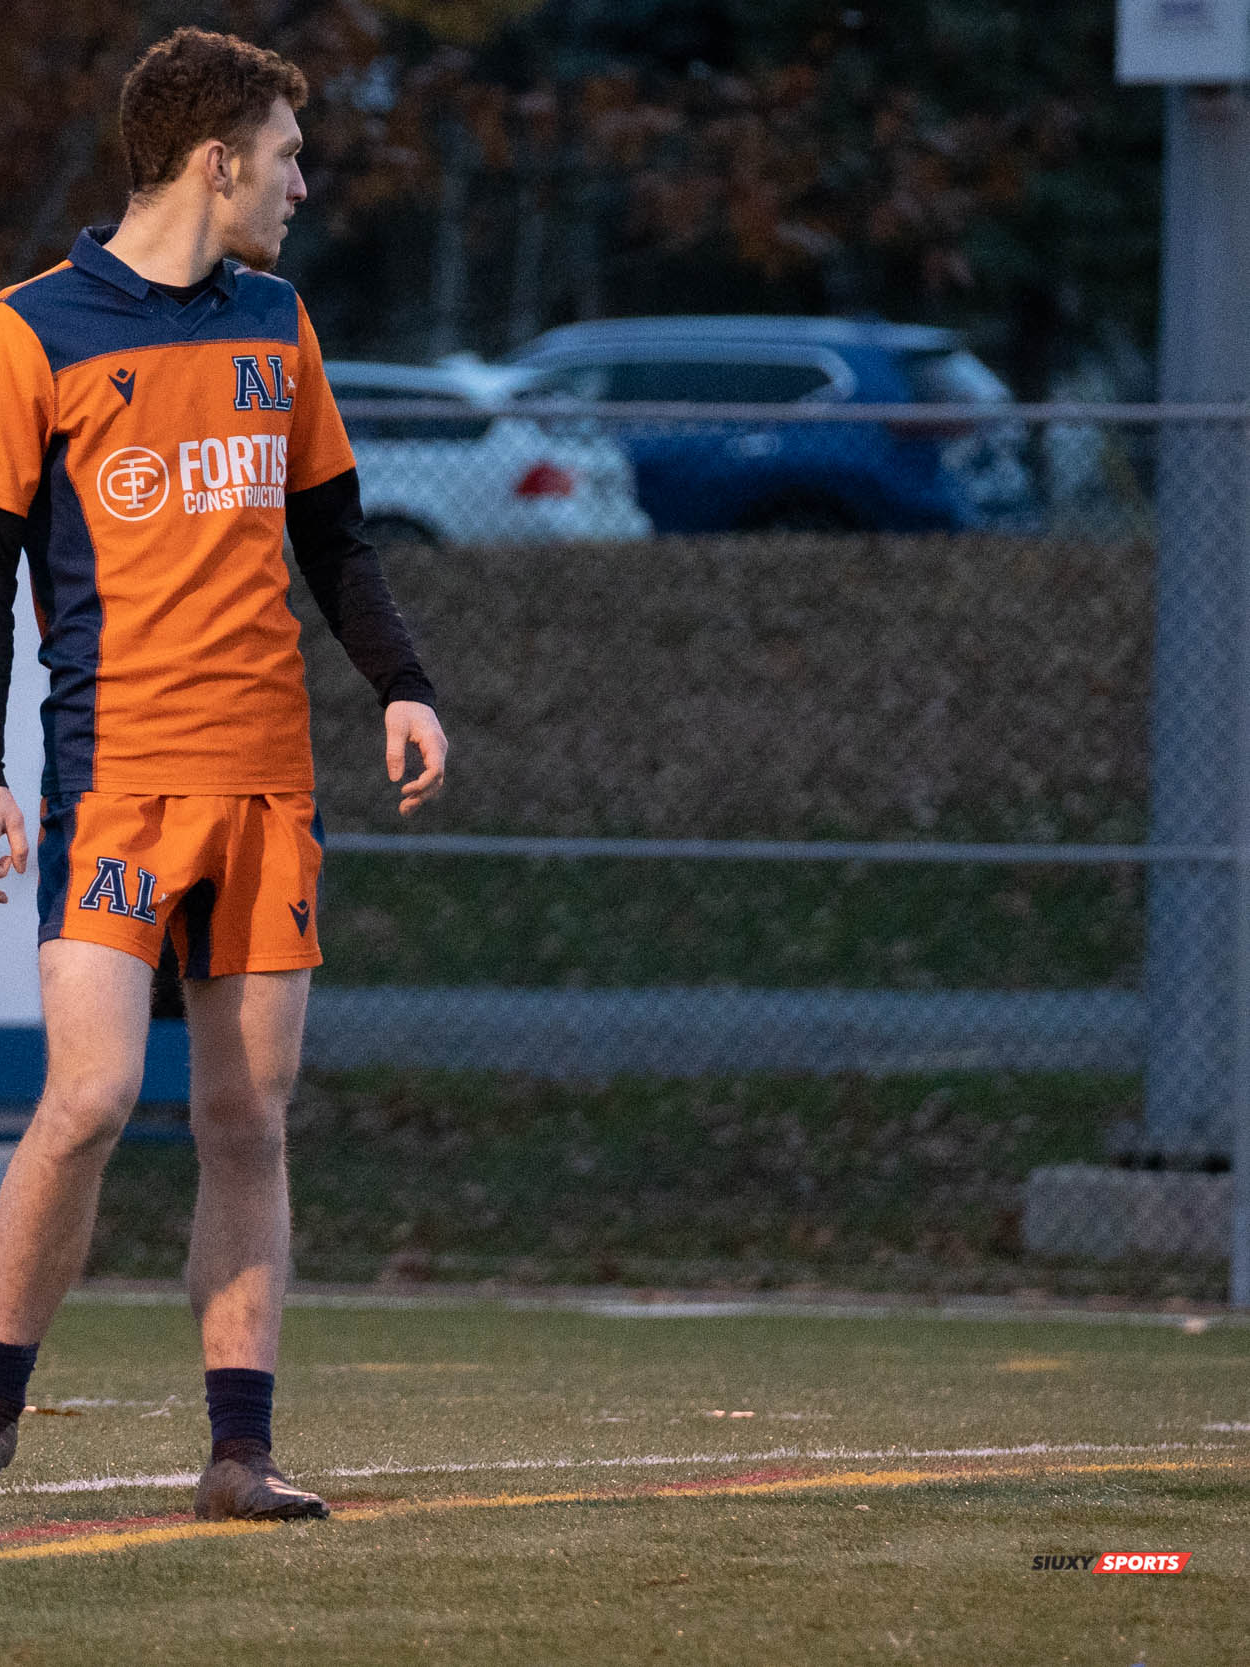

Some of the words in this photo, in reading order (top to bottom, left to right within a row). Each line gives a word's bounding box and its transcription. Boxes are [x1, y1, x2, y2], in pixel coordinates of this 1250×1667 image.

[232, 354, 292, 411] AL
[179, 434, 286, 491] FORTIS
[79, 857, 157, 925] AL
